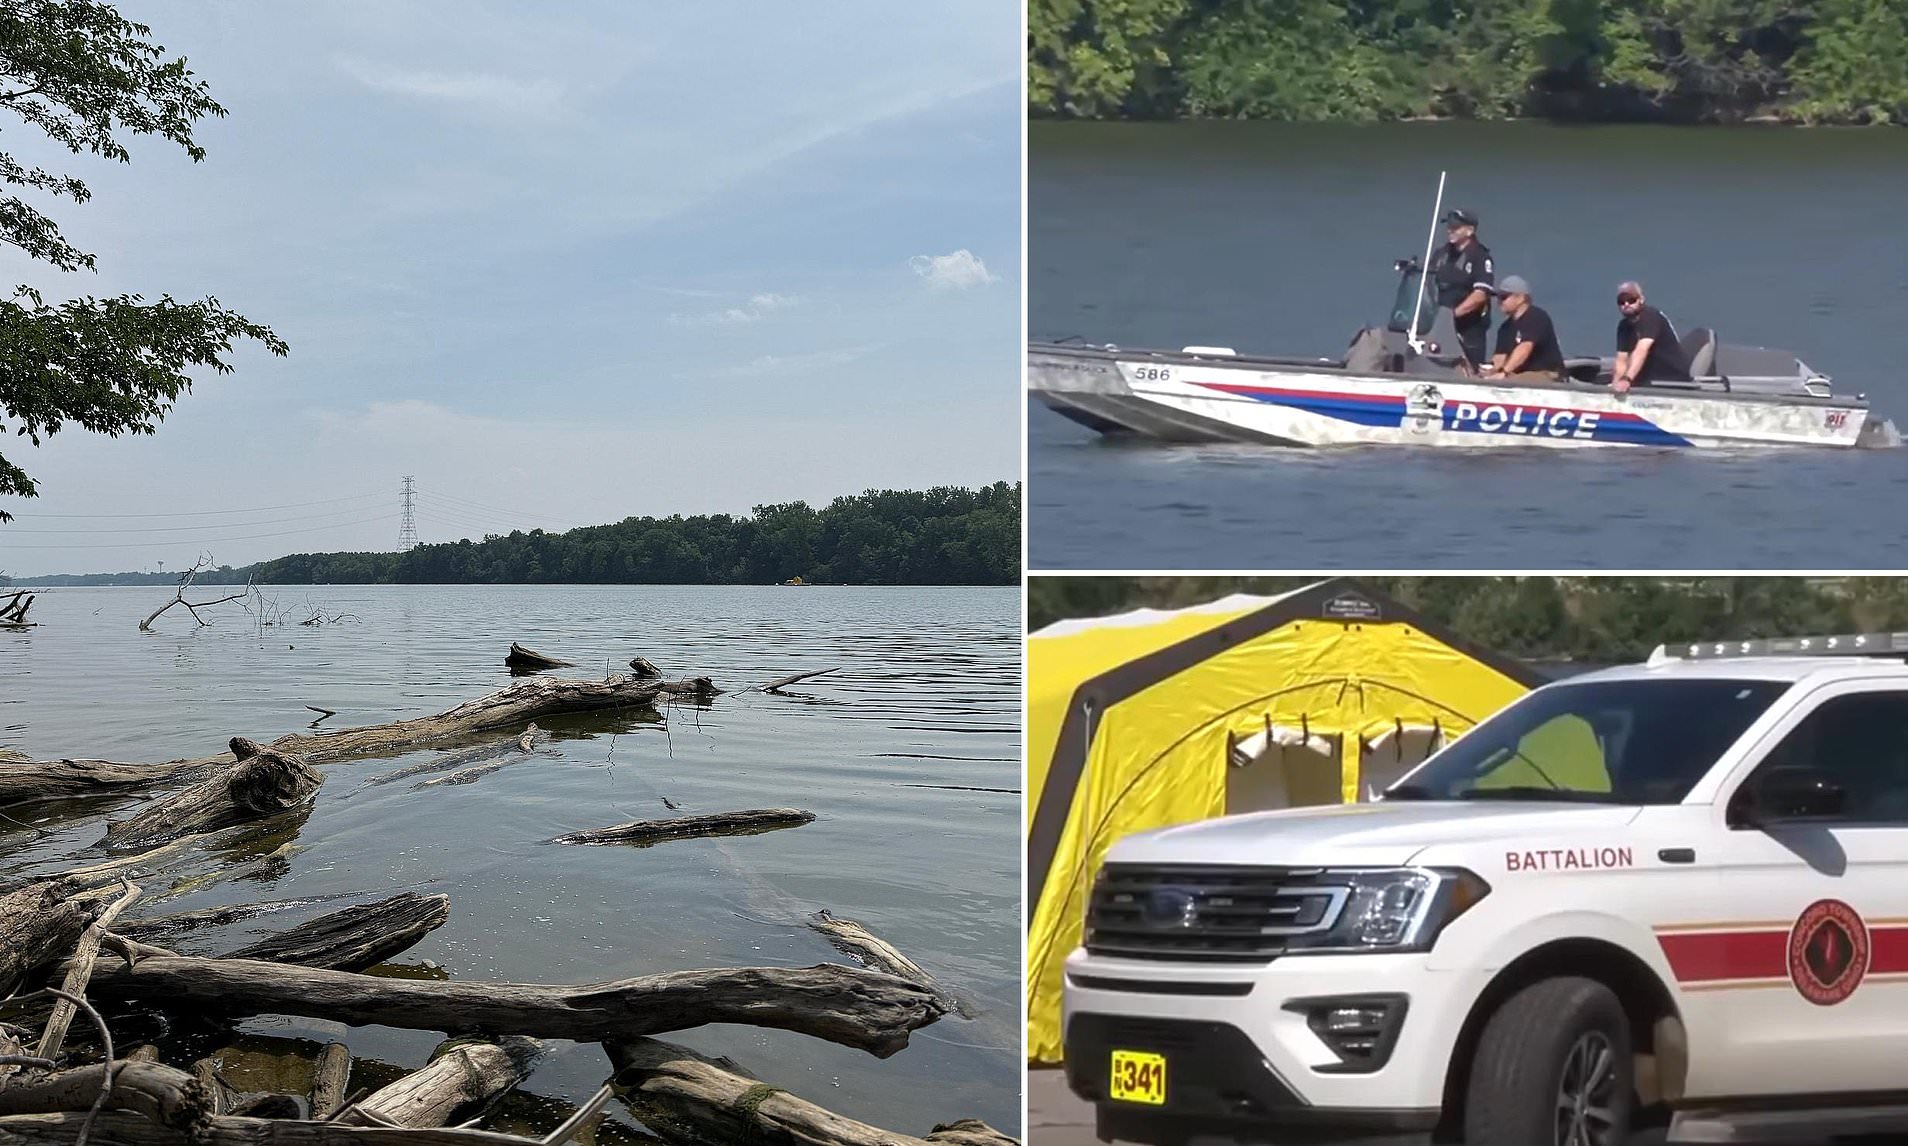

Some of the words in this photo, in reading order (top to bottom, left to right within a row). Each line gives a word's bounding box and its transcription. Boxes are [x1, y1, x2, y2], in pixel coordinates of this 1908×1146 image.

[1135, 367, 1171, 382] 586
[1451, 403, 1600, 438] POLICE
[1505, 847, 1633, 872] BATTALION
[1124, 1060, 1162, 1096] 341
